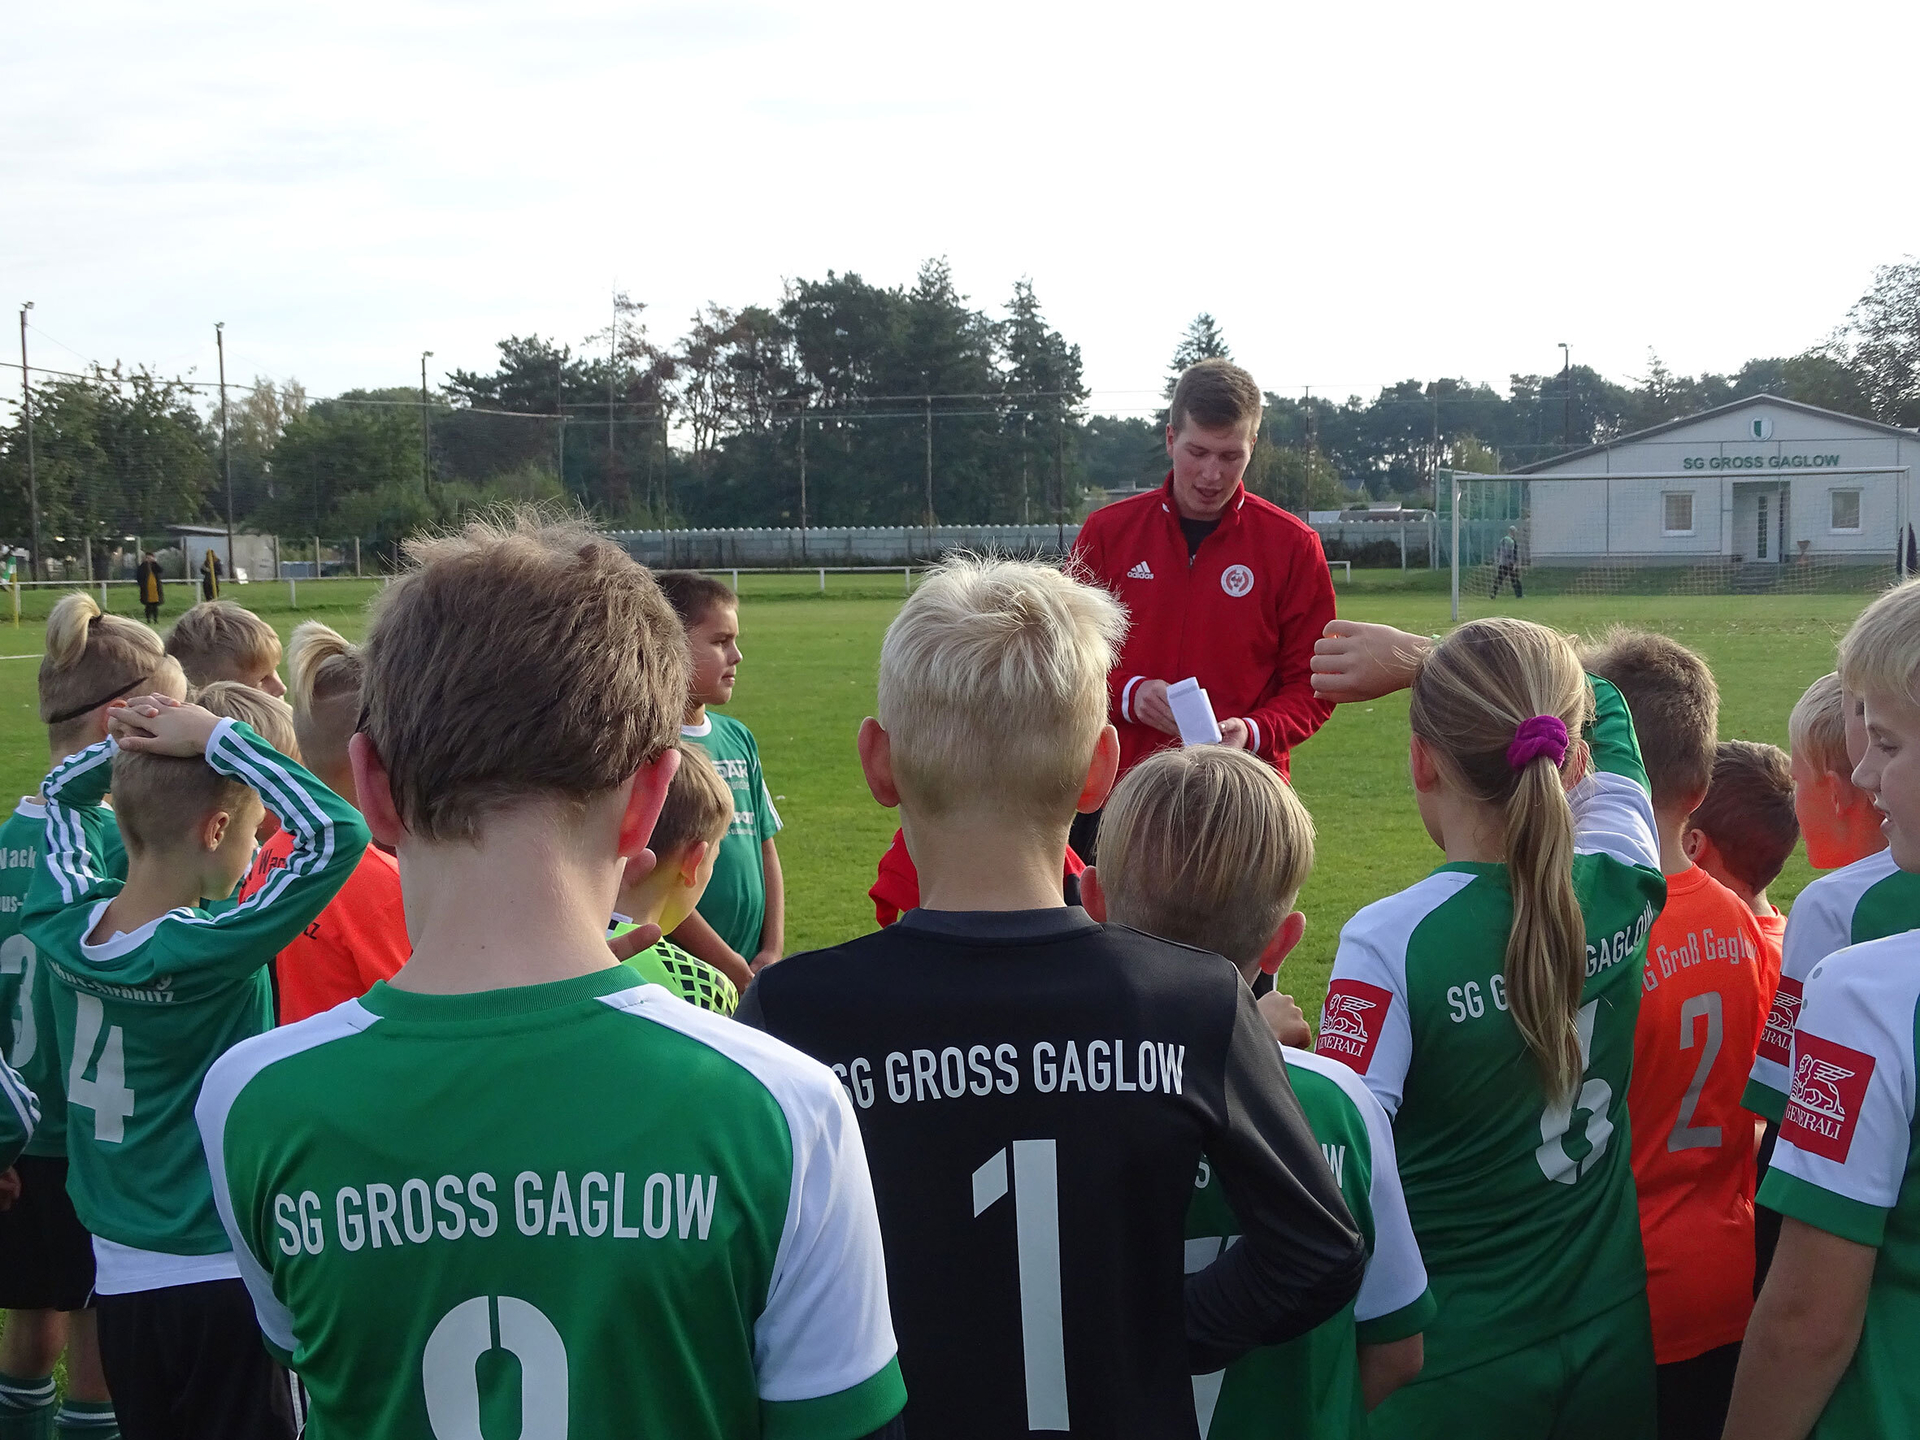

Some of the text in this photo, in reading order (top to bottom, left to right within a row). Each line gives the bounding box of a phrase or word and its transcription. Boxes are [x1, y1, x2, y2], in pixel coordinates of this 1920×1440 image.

[1683, 454, 1840, 470] SG GROSS GAGLOW
[1656, 932, 1701, 979] Groß
[0, 934, 38, 1068] 3
[1446, 981, 1485, 1023] SG
[67, 991, 135, 1144] 4
[832, 1039, 1186, 1110] SG GROSS GAGLOW
[1667, 991, 1724, 1153] 2
[1785, 1104, 1843, 1140] GENERALI
[274, 1170, 719, 1256] SG GROSS GAGLOW
[972, 1139, 1070, 1431] 1
